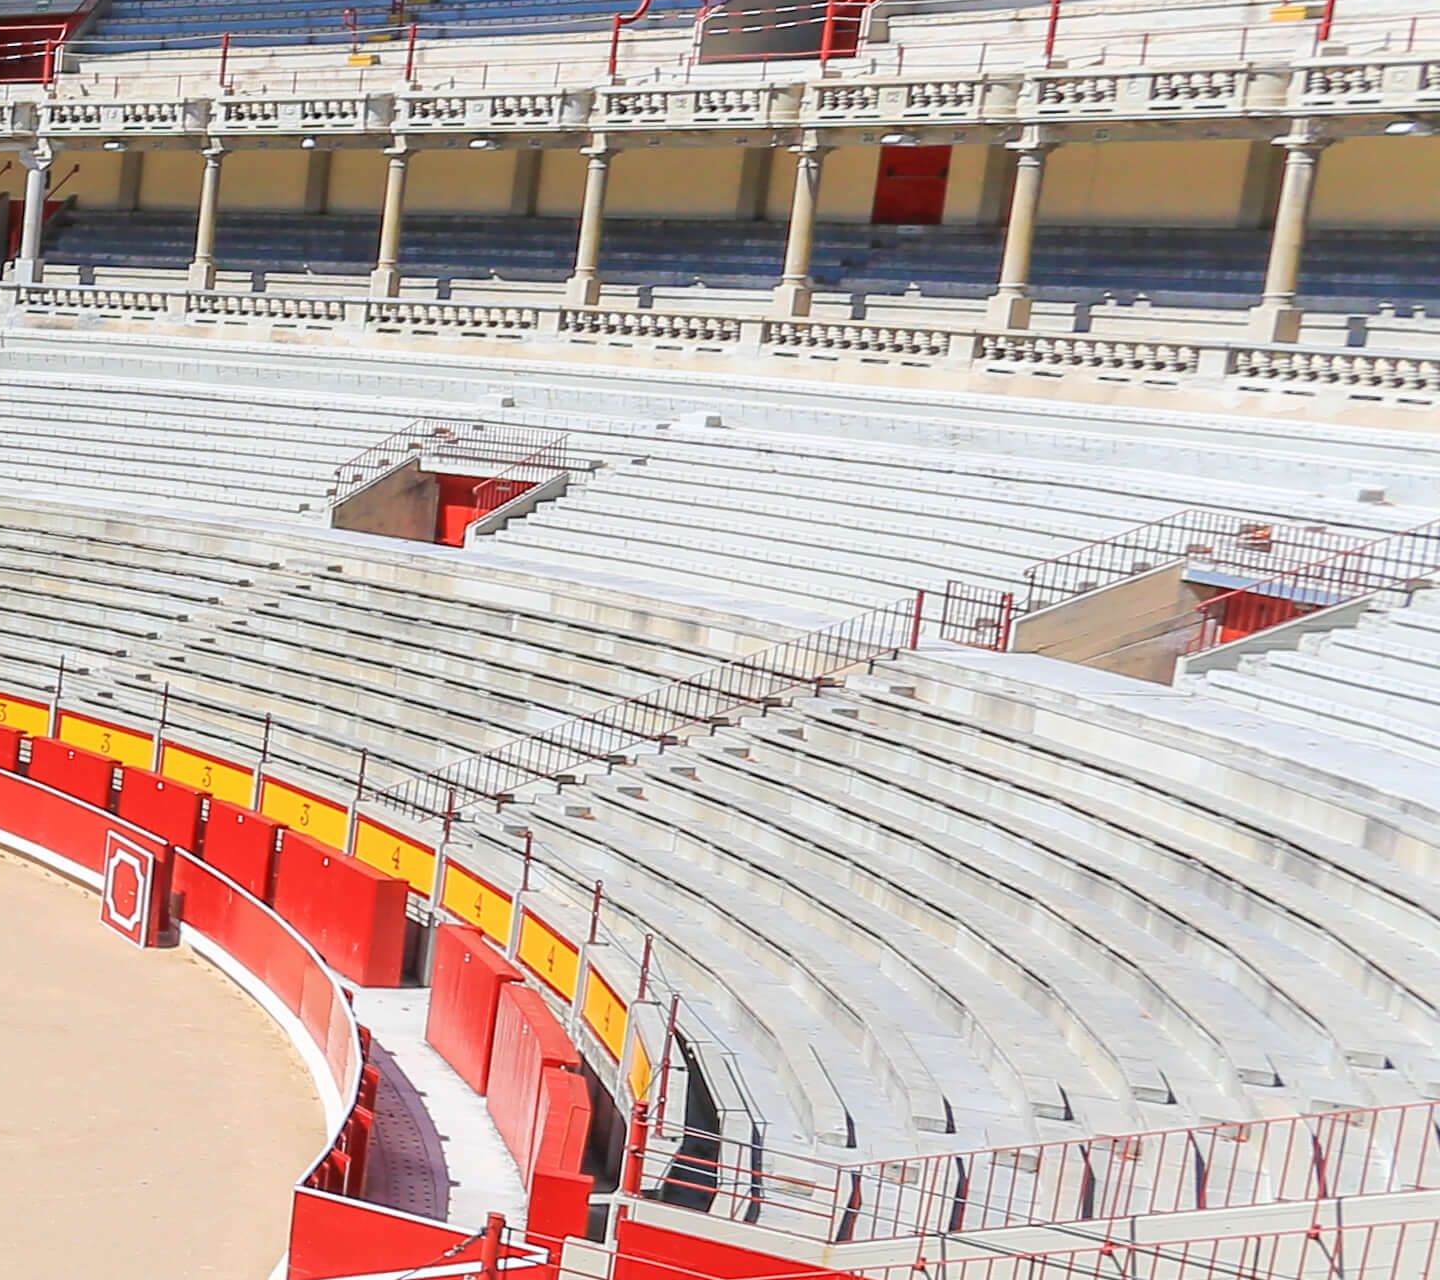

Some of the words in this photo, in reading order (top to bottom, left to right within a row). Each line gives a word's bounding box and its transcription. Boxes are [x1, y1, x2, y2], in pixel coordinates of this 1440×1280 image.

[101, 733, 111, 753] 3
[202, 766, 213, 788] 3
[300, 803, 310, 826] 3
[391, 846, 401, 870] 4
[474, 892, 483, 918] 4
[547, 944, 555, 973] 4
